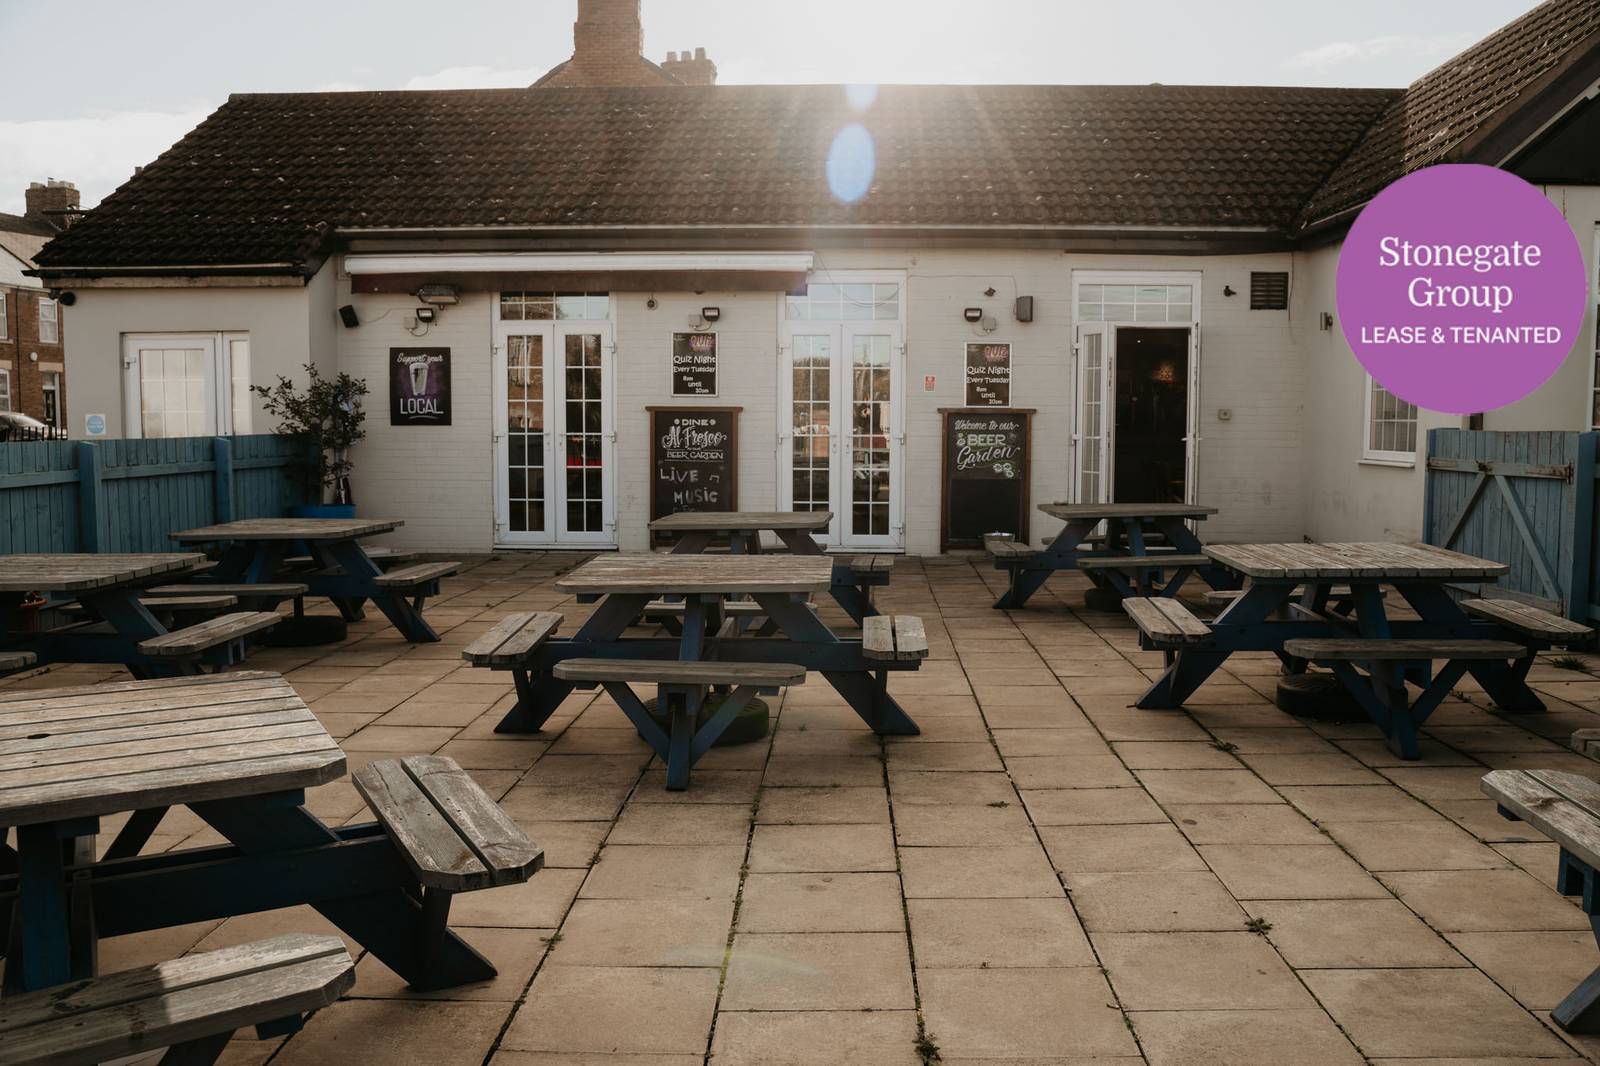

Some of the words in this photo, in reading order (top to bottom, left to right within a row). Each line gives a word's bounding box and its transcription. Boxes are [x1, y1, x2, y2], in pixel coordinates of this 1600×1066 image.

[673, 355, 693, 365] Quiz
[693, 355, 716, 364] Night
[967, 366, 987, 375] Quiz
[987, 366, 1011, 375] Night
[400, 398, 444, 415] LOCAL
[954, 419, 987, 430] Welcome
[988, 420, 998, 430] to
[999, 421, 1020, 430] our
[661, 425, 681, 448] Al
[681, 426, 728, 449] Fresco
[967, 433, 1007, 446] BEER
[666, 451, 690, 459] BEER
[690, 451, 724, 460] GARDEN
[956, 445, 1021, 470] Garden
